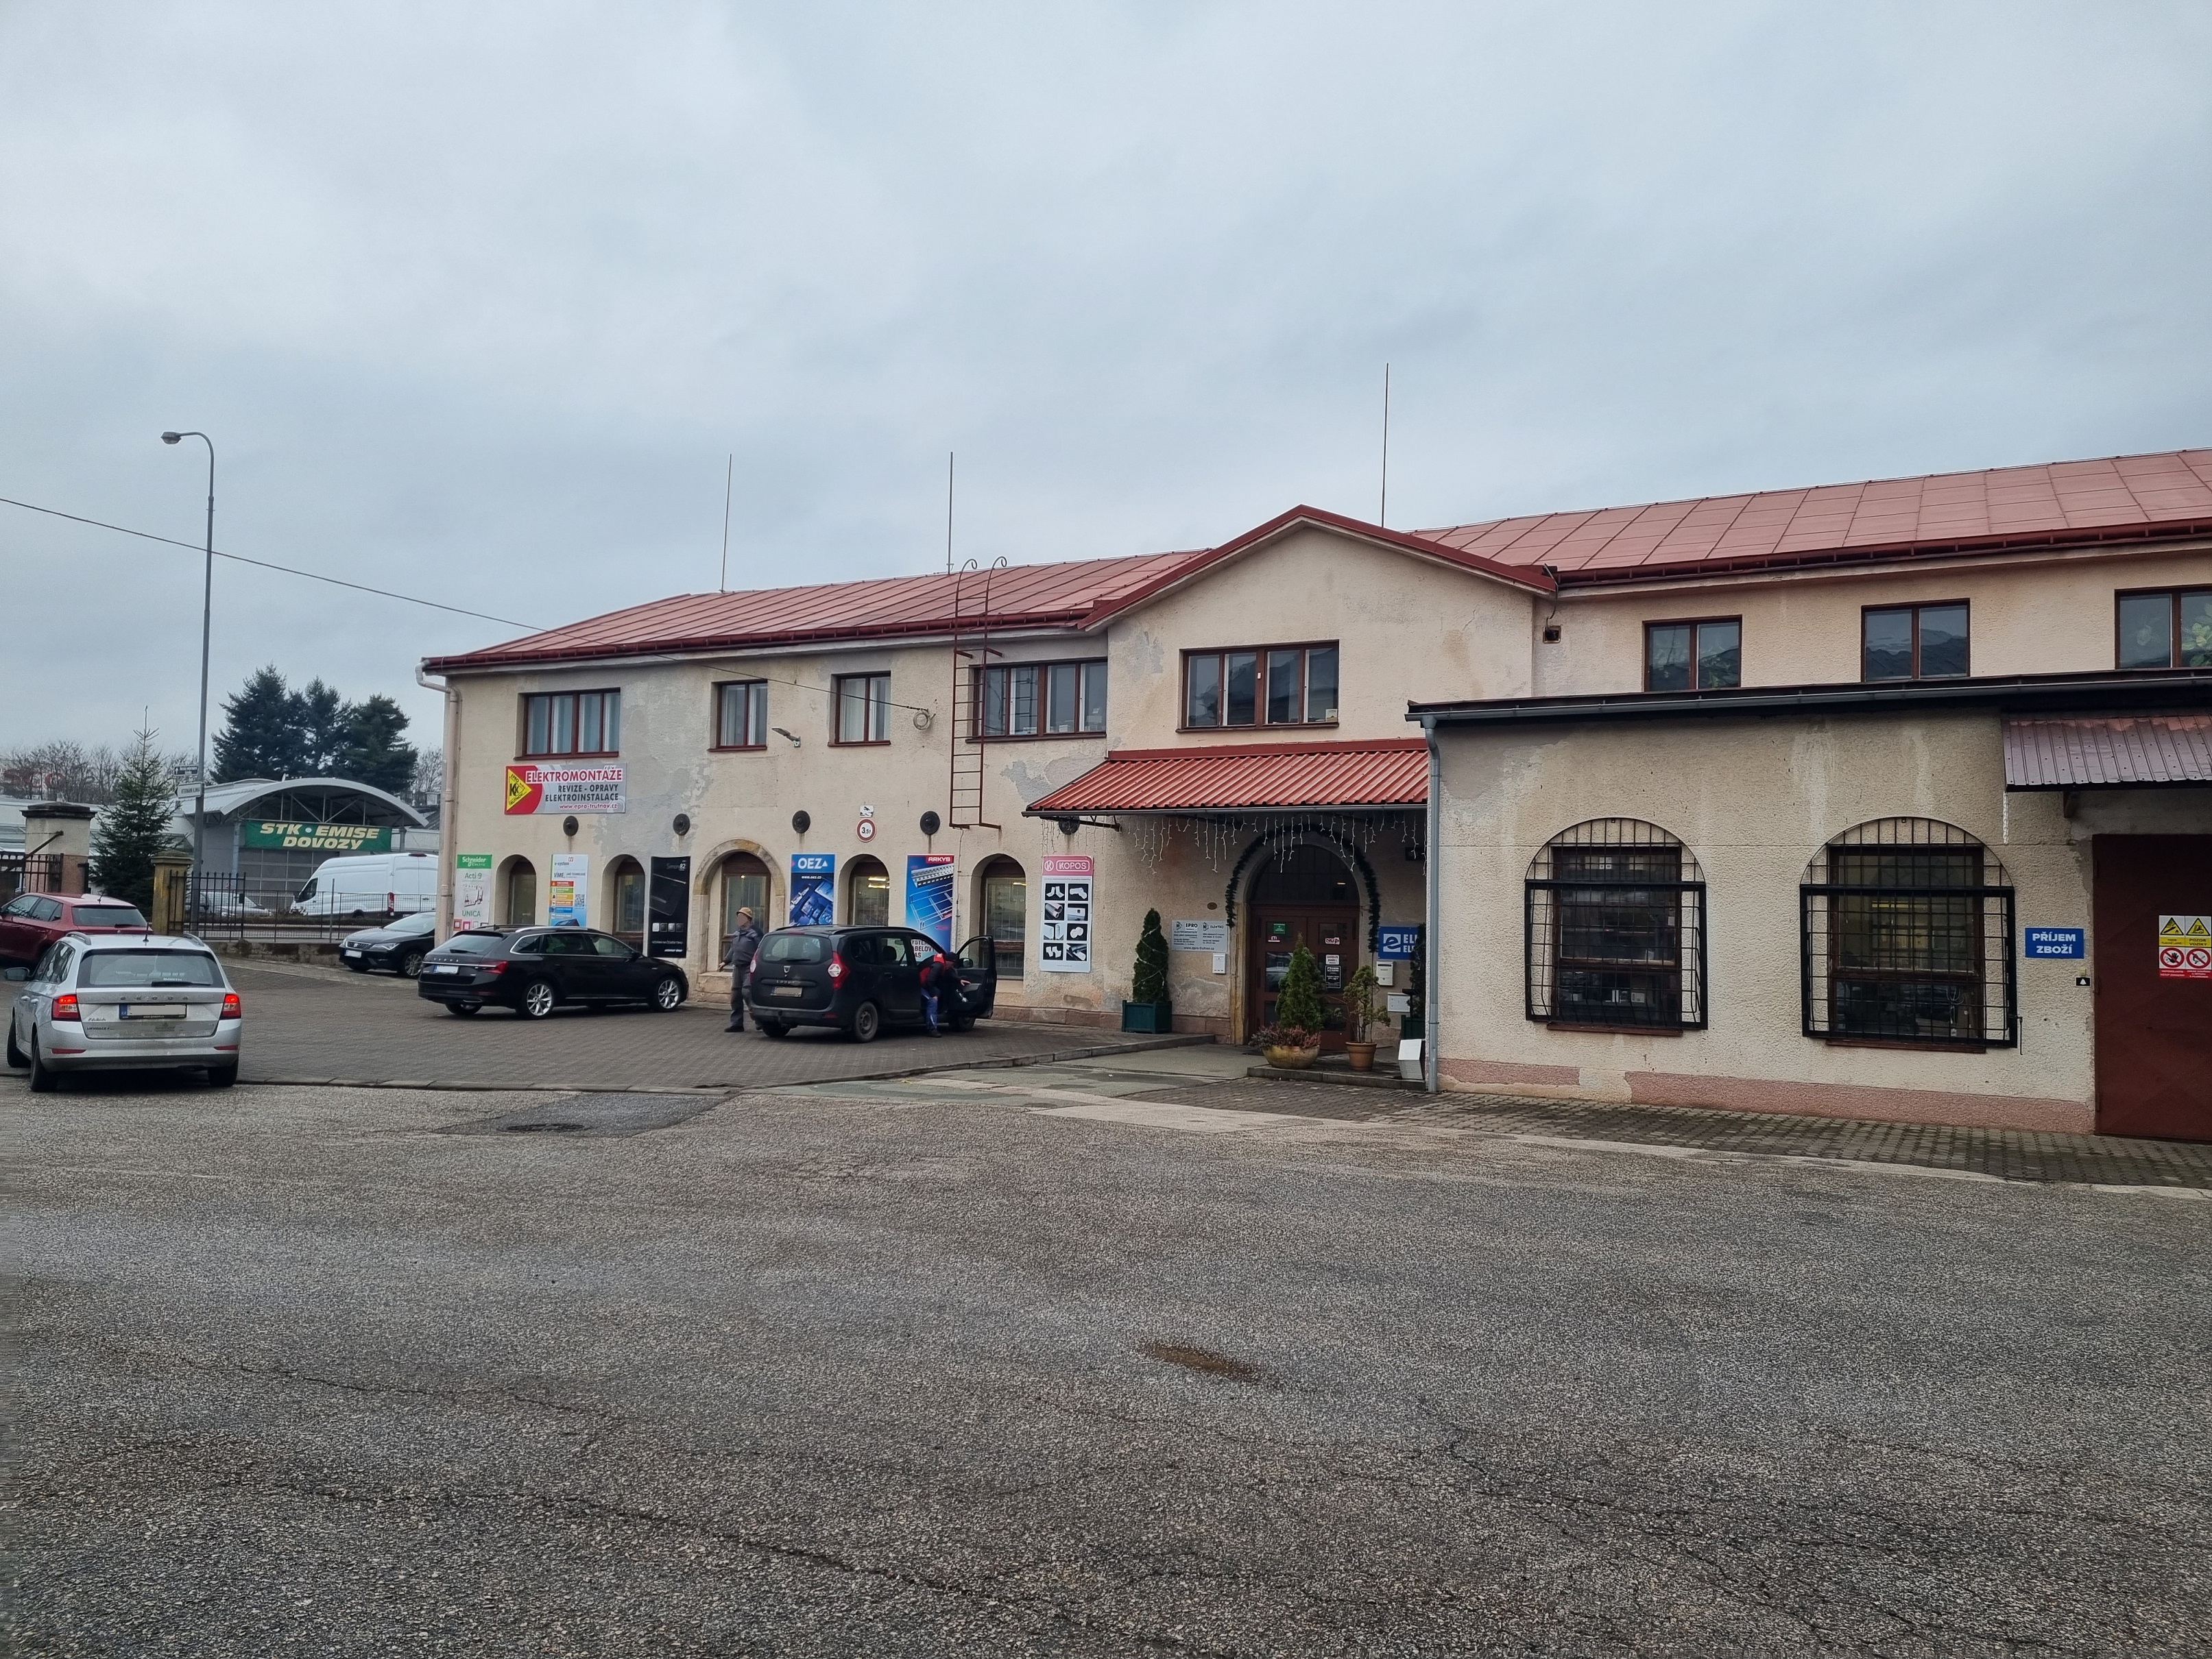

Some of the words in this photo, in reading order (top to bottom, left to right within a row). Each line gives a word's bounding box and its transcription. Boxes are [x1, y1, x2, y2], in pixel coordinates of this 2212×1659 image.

[527, 766, 622, 783] ELEKTROMONTÁŽE
[545, 793, 618, 801] ELEKTROINSTALACE
[260, 823, 302, 835] STK
[315, 825, 380, 838] EMISE
[282, 836, 363, 850] DOVOZY
[461, 856, 487, 867] Schneider
[797, 858, 822, 869] OEZ
[1059, 862, 1087, 870] KOPOS
[2032, 931, 2076, 942] PŘÍJEM
[2036, 944, 2073, 954] ZBOŽÍ
